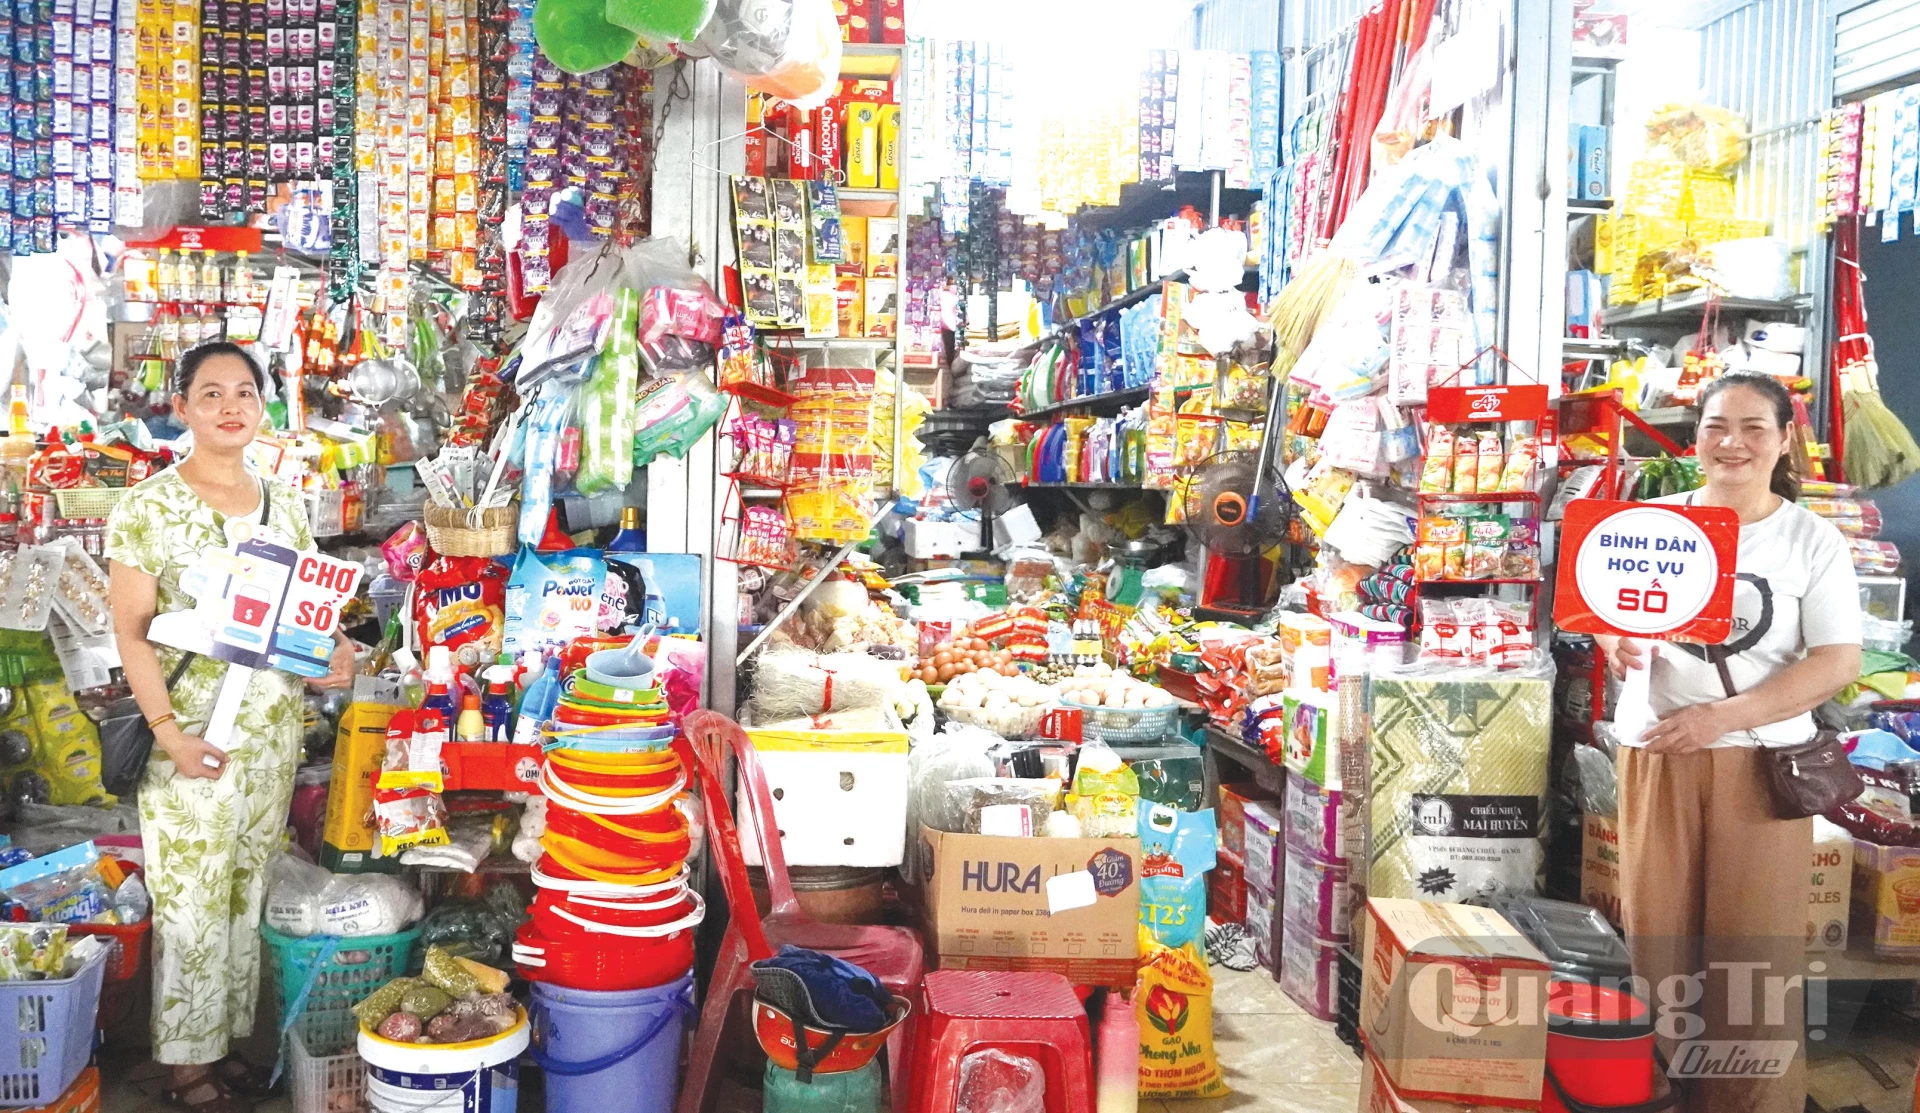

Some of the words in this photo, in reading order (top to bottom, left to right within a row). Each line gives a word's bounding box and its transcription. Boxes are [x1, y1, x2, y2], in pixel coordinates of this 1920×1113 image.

[1600, 532, 1648, 549] BÌNH
[1655, 536, 1697, 553] DÂN
[1607, 557, 1649, 574] HỌC
[1657, 561, 1684, 577] VỤ
[299, 557, 357, 598] CHỢ
[569, 598, 592, 611] 100
[601, 592, 626, 610] ene
[1617, 578, 1668, 613] SỐ
[295, 599, 337, 631] SỐ
[1463, 819, 1487, 831] MAI
[1812, 848, 1842, 867] HÔ
[962, 861, 1041, 894] HURA
[1000, 908, 1019, 916] paper
[1021, 908, 1033, 916] box
